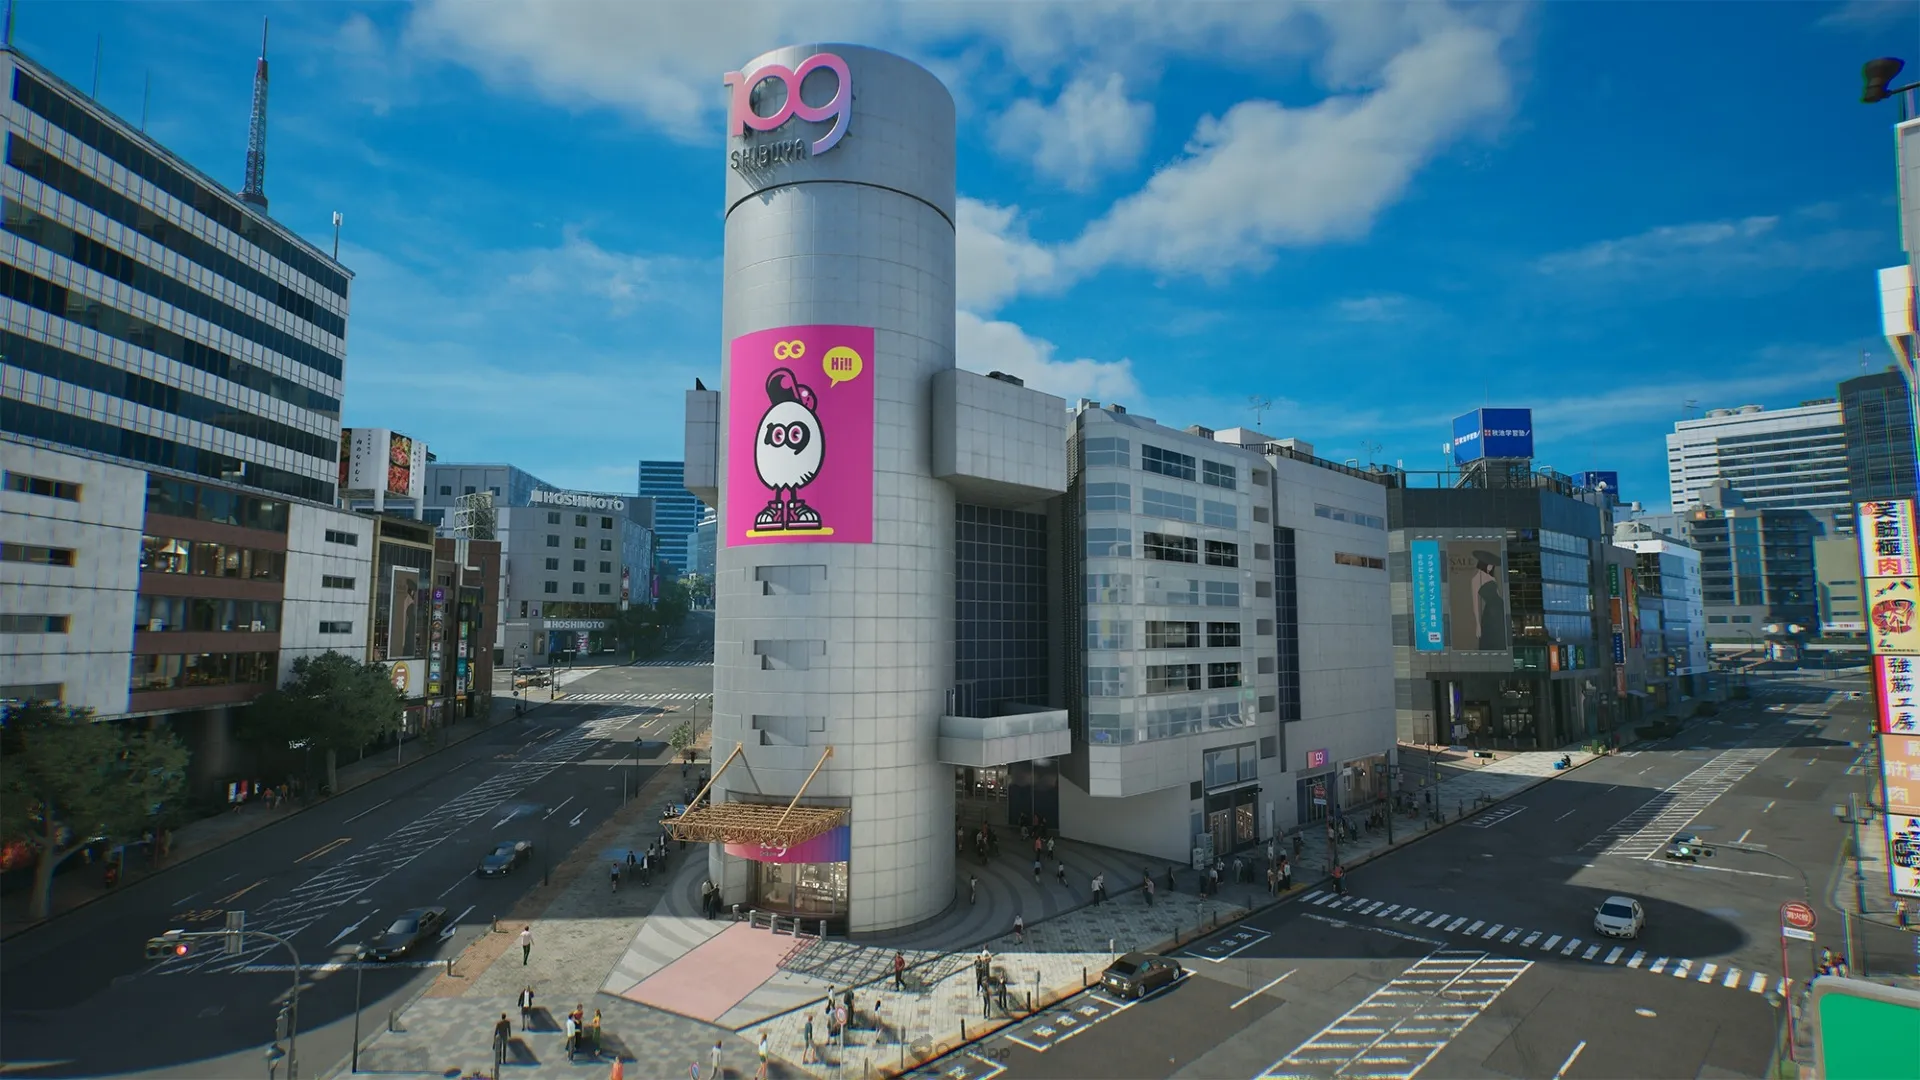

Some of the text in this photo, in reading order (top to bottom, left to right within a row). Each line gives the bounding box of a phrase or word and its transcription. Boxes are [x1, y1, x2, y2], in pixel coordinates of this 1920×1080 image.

[723, 52, 852, 156] 109
[730, 138, 807, 170] SHIBUYA
[831, 356, 853, 371] Hi!!
